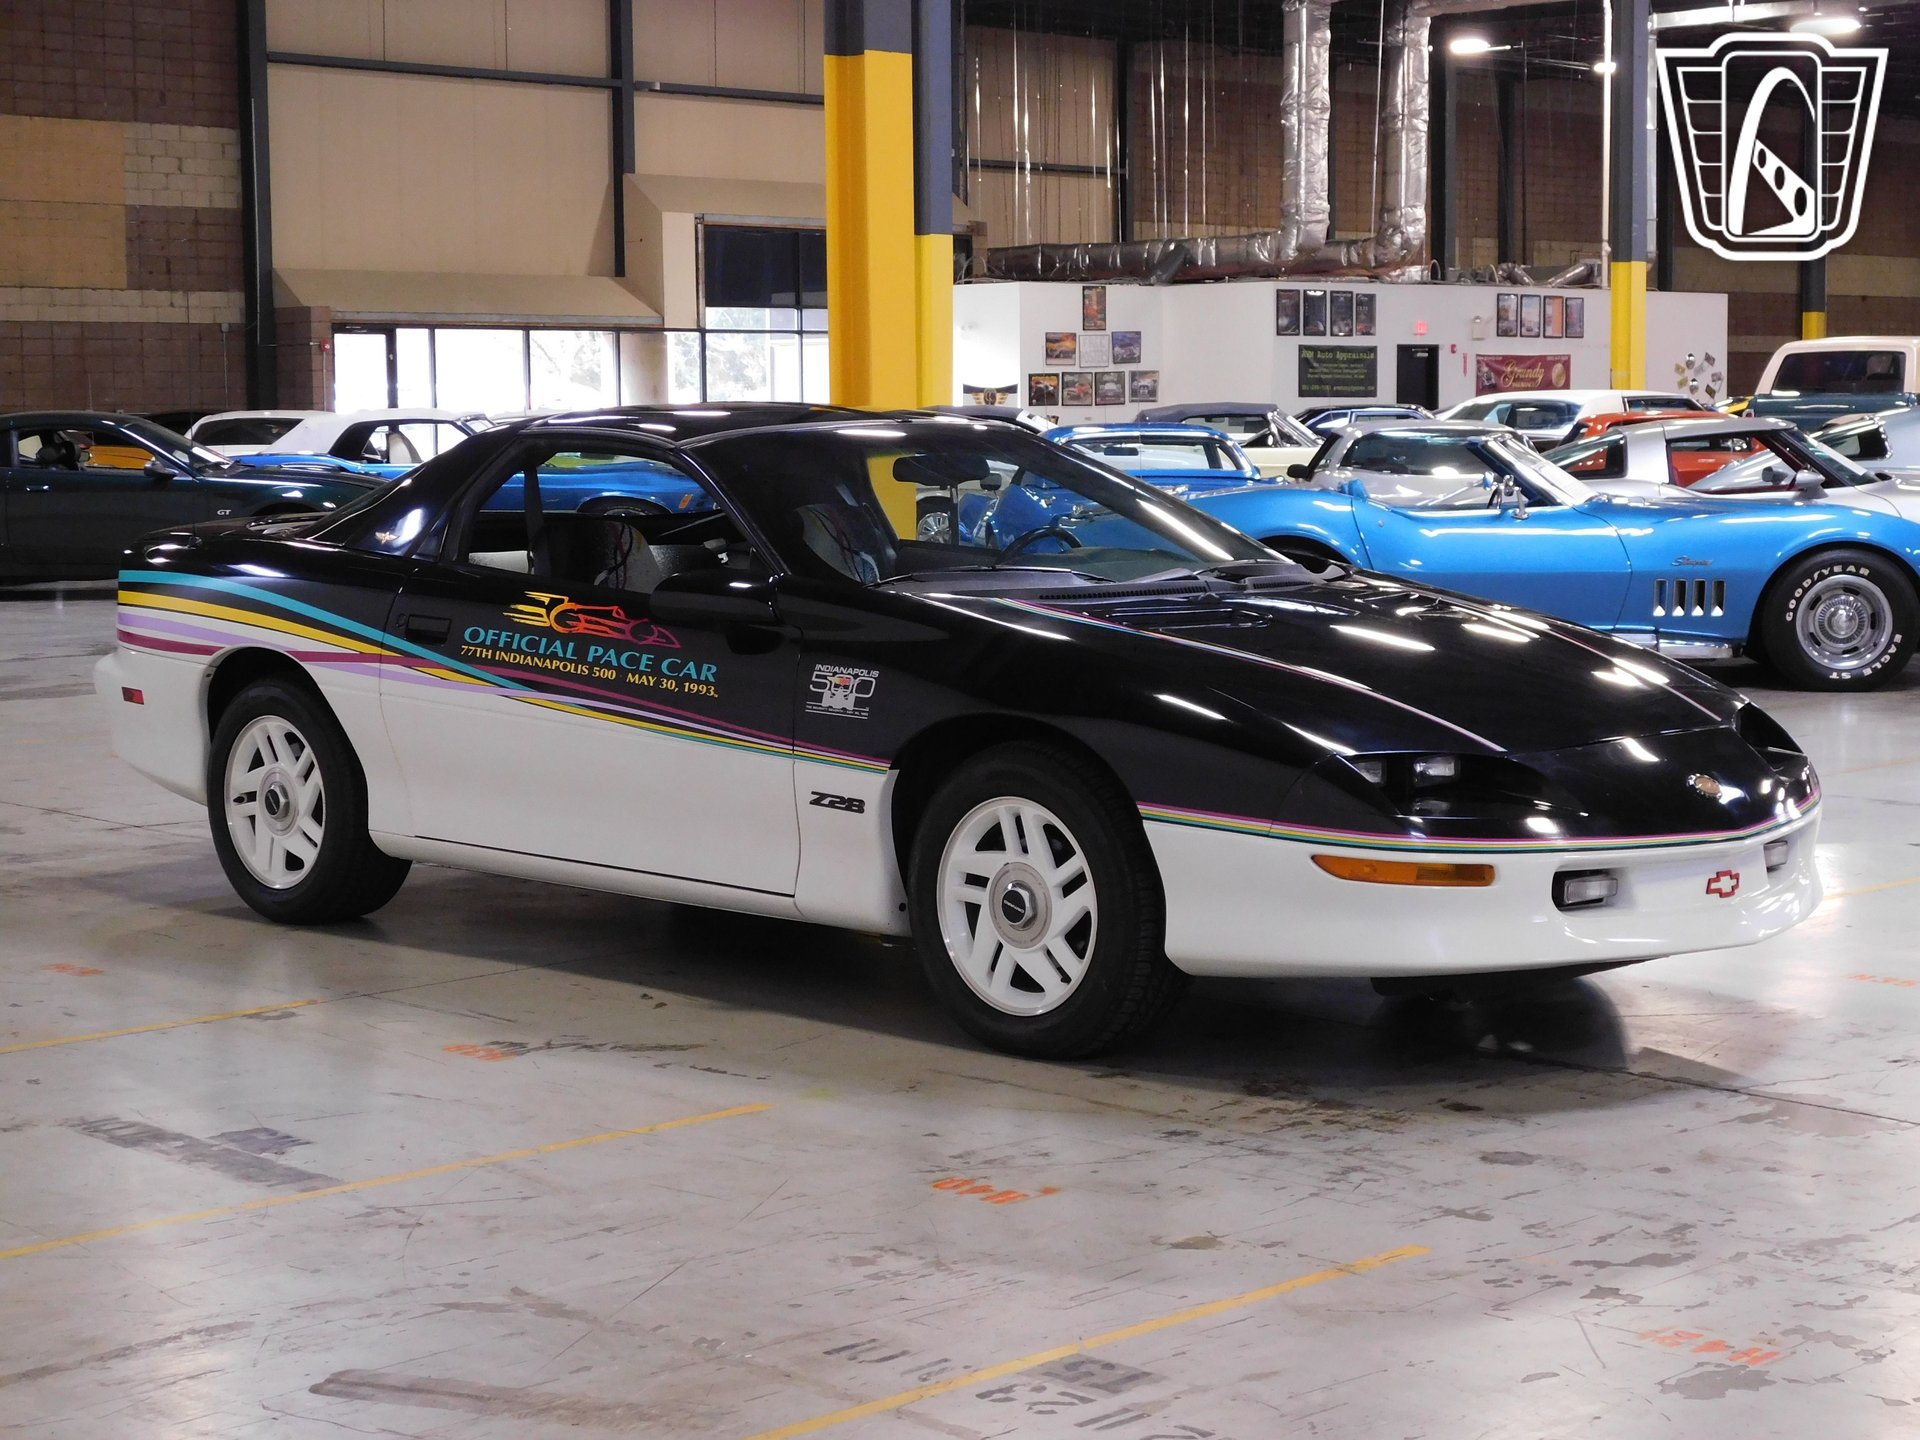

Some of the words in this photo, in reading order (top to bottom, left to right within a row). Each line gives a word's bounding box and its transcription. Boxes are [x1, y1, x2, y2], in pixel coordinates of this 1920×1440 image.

[1501, 359, 1545, 388] Grundy
[1785, 565, 1870, 622] GOODYEAR
[461, 645, 492, 659] 77TH
[495, 650, 589, 676] INDIANAPOLIS
[591, 667, 616, 680] 500
[626, 672, 657, 687] MAY
[659, 678, 679, 692] 30,
[464, 626, 577, 660] OFFICIAL
[587, 645, 655, 672] PACE
[661, 658, 717, 683] CAR
[1862, 633, 1903, 676] EAGLE
[809, 671, 876, 698] 500
[815, 664, 879, 677] INDIANAPOLIS
[1829, 671, 1852, 680] ST
[809, 791, 866, 814] Z28
